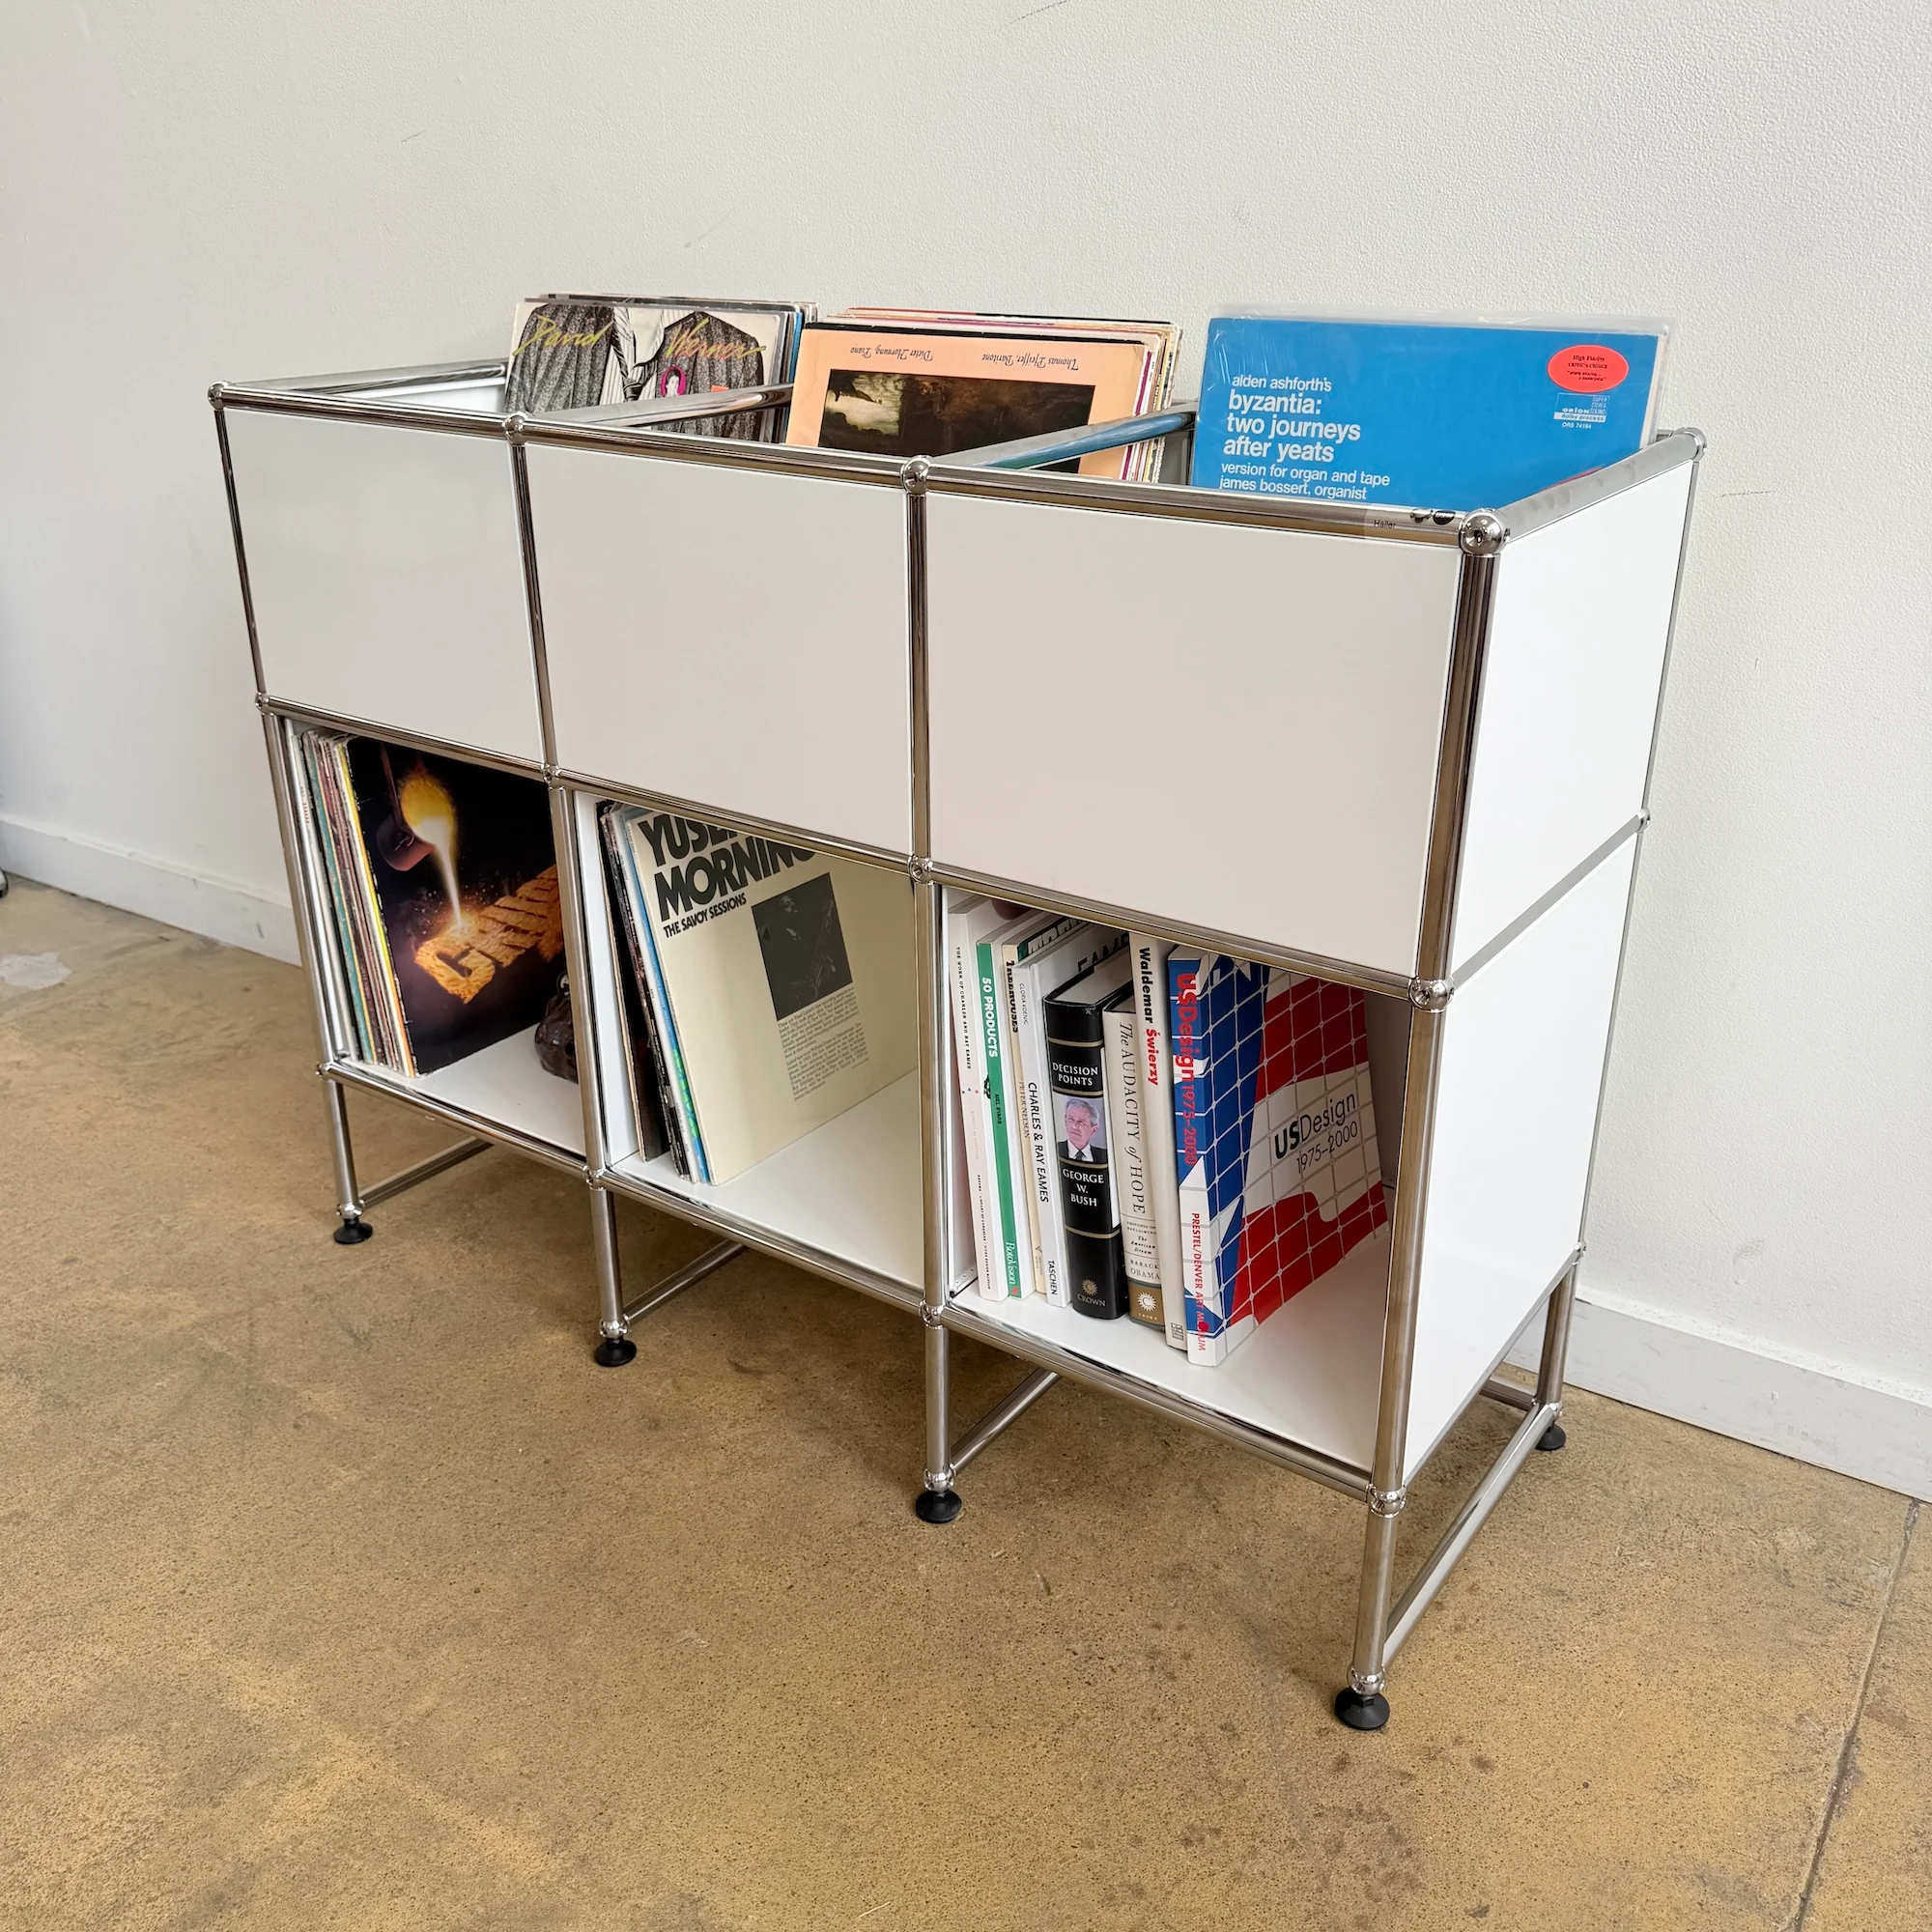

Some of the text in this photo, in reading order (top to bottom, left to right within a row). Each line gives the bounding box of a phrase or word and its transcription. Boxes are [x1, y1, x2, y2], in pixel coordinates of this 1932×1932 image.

[850, 347, 871, 358] Piano
[981, 354, 1014, 366] Baritone
[1048, 356, 1079, 371] Thomas
[1232, 375, 1332, 392] alden ashforth's
[1229, 388, 1321, 414] byzantia:
[1227, 412, 1361, 444] two journeys
[1223, 436, 1334, 463] after yeats
[1219, 475, 1367, 500] james bossert, organist
[1221, 463, 1390, 488] version for organ and tape
[663, 893, 748, 939] THE SAVOY SESSIONS
[1139, 948, 1153, 1024] Waldemar
[981, 978, 998, 1057] 50 PRODUCTS
[1176, 973, 1201, 1082] USDesign
[1053, 1063, 1098, 1076] DECISION
[1059, 1074, 1093, 1086] POINTS
[1120, 1022, 1146, 1214] The AUDACITY of HOPE
[1275, 1094, 1356, 1159] USDesign
[1028, 1082, 1049, 1203] CHARLES & RAY EAMES
[1063, 1169, 1104, 1184] GEORGE
[1076, 1183, 1088, 1194] W.
[1070, 1194, 1097, 1207] BUSH
[1006, 1242, 1017, 1285] RotoVision
[1130, 1259, 1159, 1269] BARACK
[1130, 1267, 1160, 1281] OBAMA
[1048, 1260, 1059, 1294] TASCHEN
[1077, 1293, 1106, 1306] CROWN
[1194, 1291, 1204, 1310] ART
